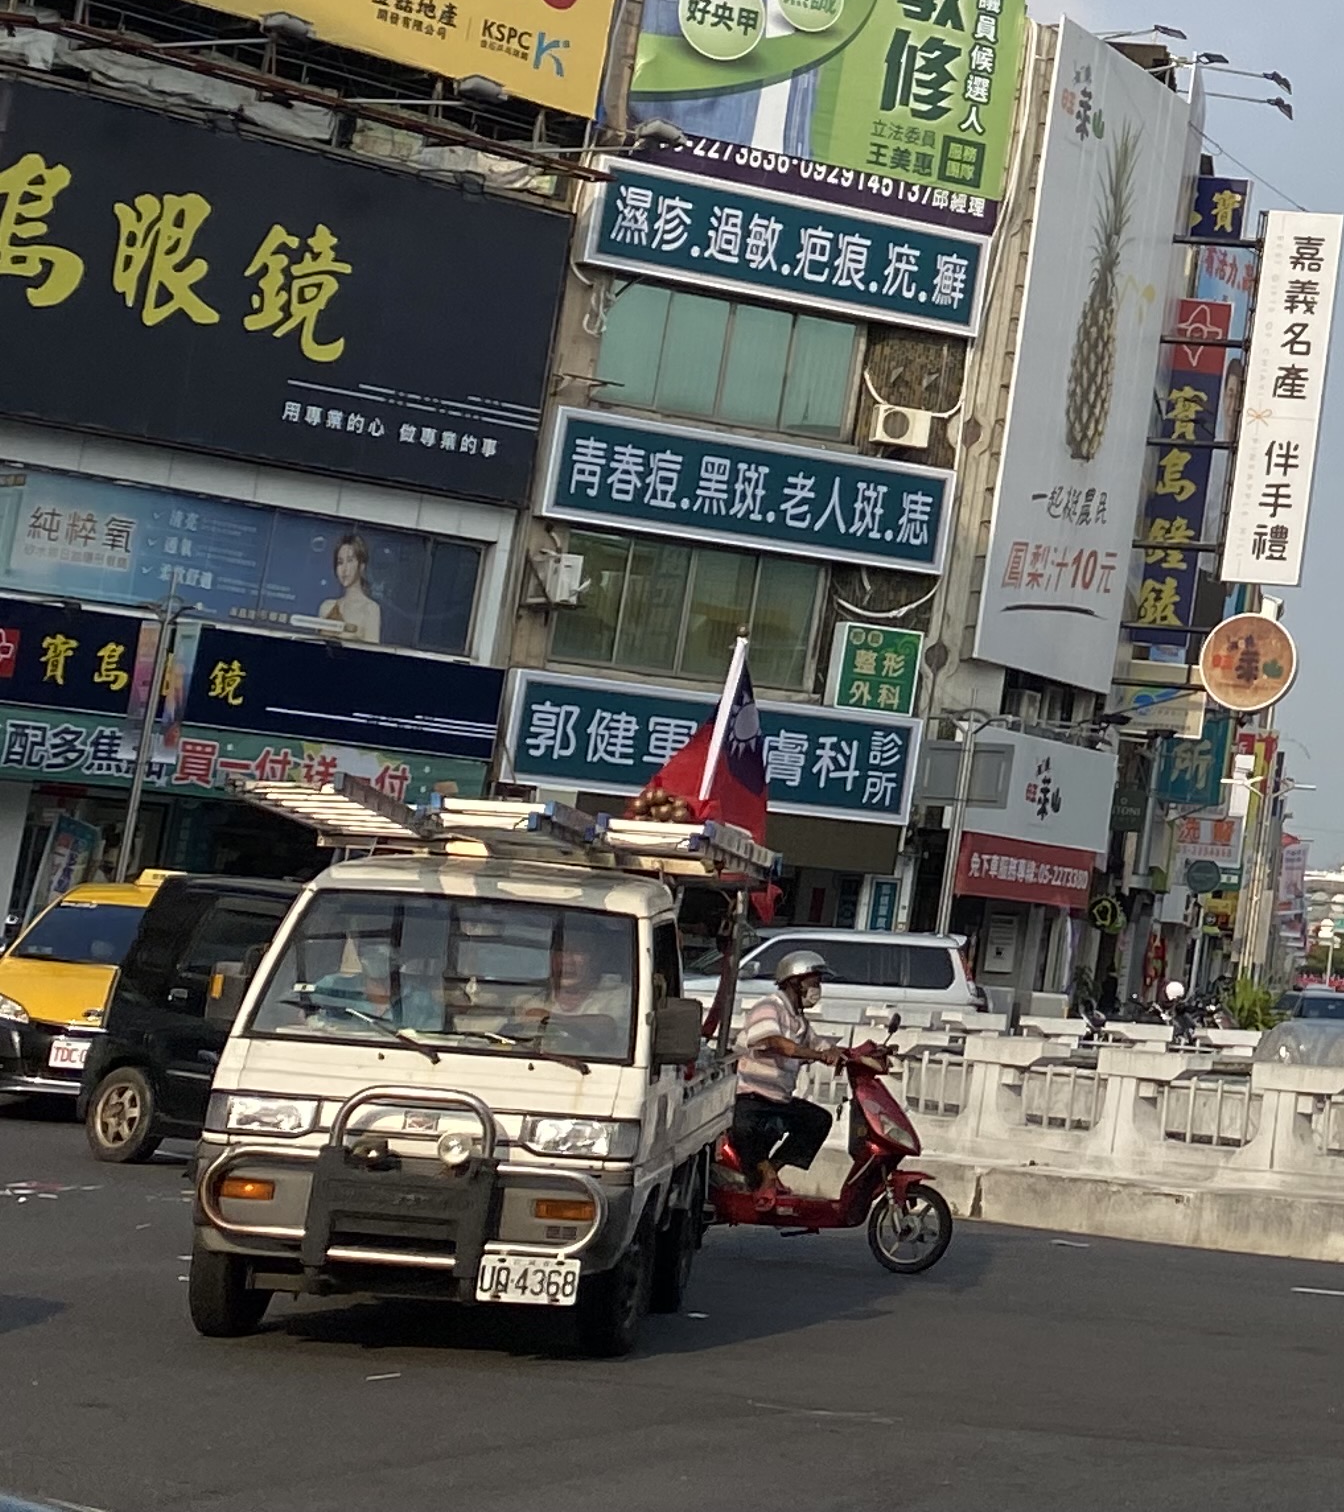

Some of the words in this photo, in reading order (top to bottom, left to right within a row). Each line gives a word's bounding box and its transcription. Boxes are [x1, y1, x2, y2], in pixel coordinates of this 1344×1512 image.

[481, 19, 533, 50] KSPC
[871, 120, 936, 149] 立法委員
[867, 142, 935, 177] 王美惠
[1272, 236, 1326, 400] 嘉義名產
[281, 400, 386, 439] 用專業的心
[1251, 440, 1300, 561] 伴手禮
[40, 633, 248, 706] 寶島鏡
[852, 648, 906, 678] 整形
[849, 680, 901, 710] 外科
